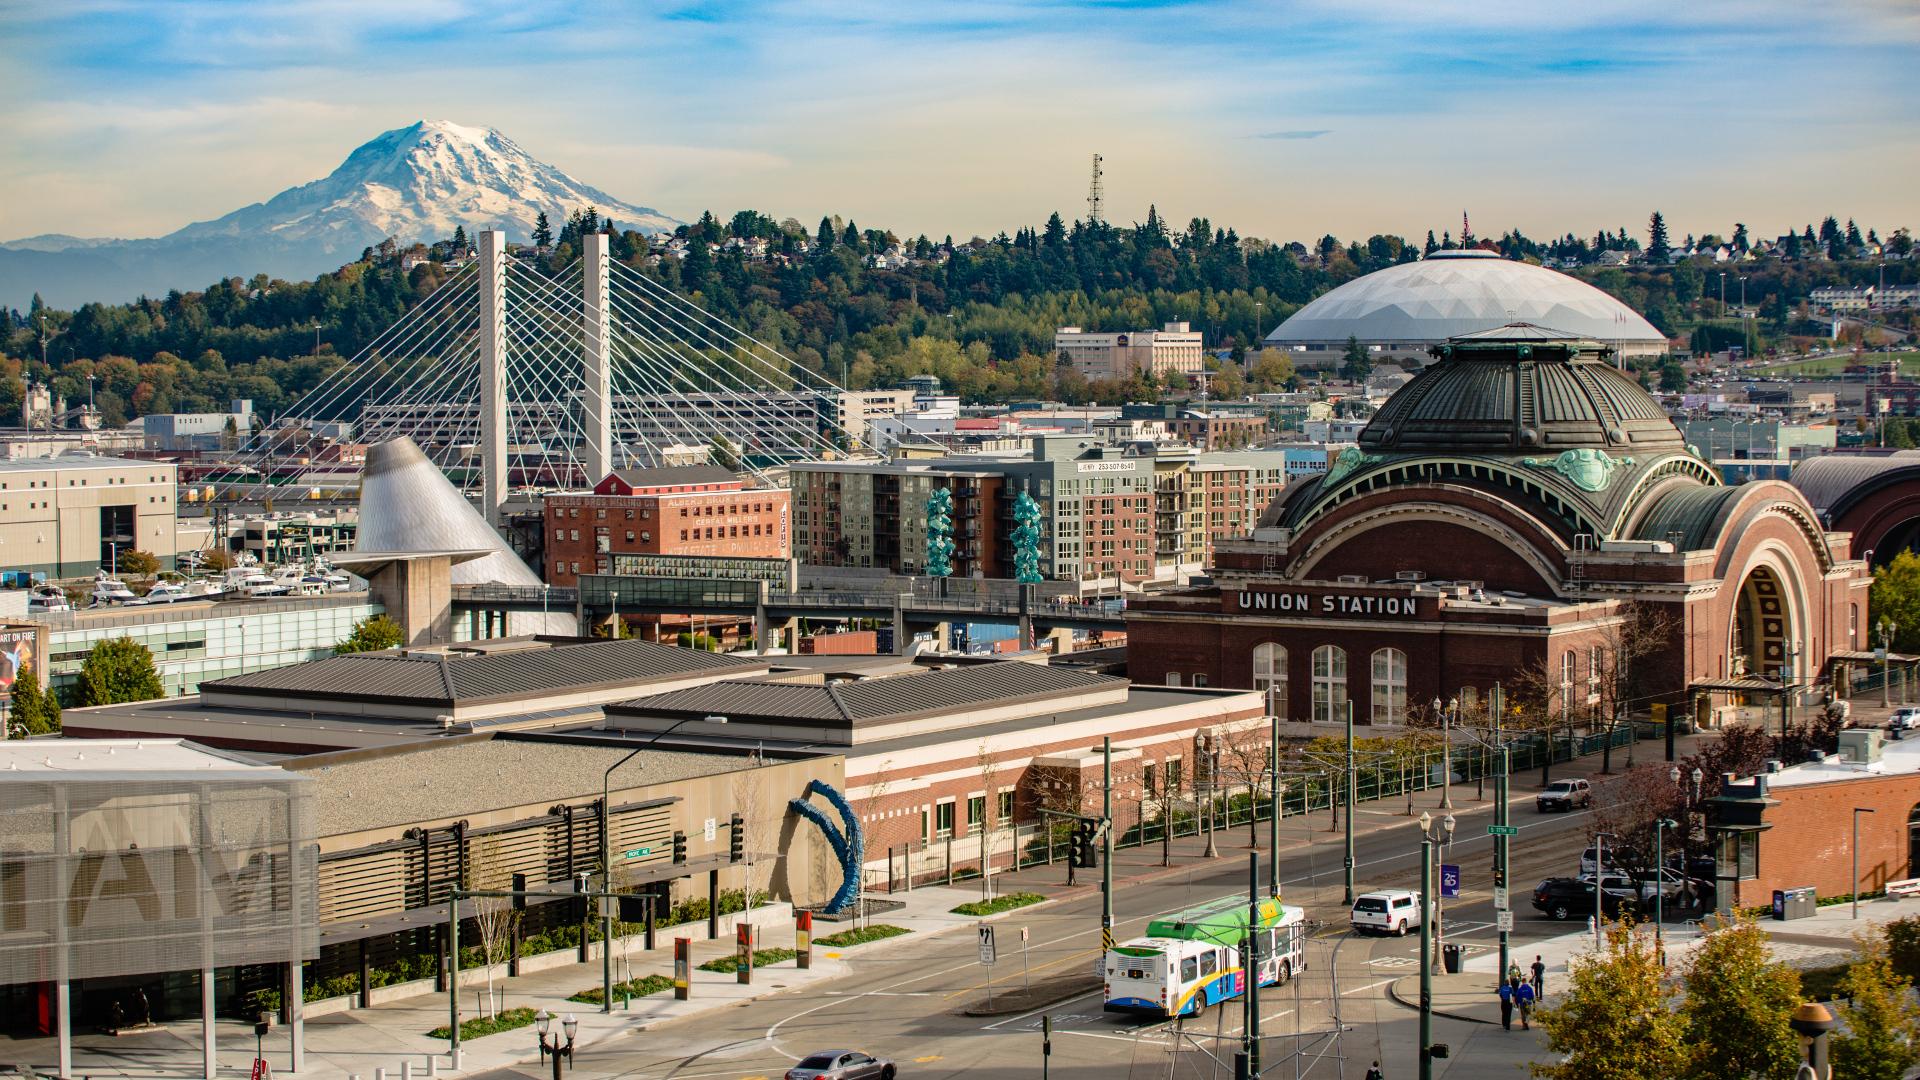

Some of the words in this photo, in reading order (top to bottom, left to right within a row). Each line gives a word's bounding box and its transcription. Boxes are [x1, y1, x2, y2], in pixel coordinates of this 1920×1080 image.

[668, 498, 703, 507] ALBERS
[695, 517, 724, 526] CEREAL
[727, 515, 759, 523] MILLERS
[1239, 592, 1308, 611] UNION
[1322, 595, 1416, 615] STATION
[12, 633, 20, 641] ON
[22, 631, 36, 640] FIRE
[1444, 873, 1457, 886] 25
